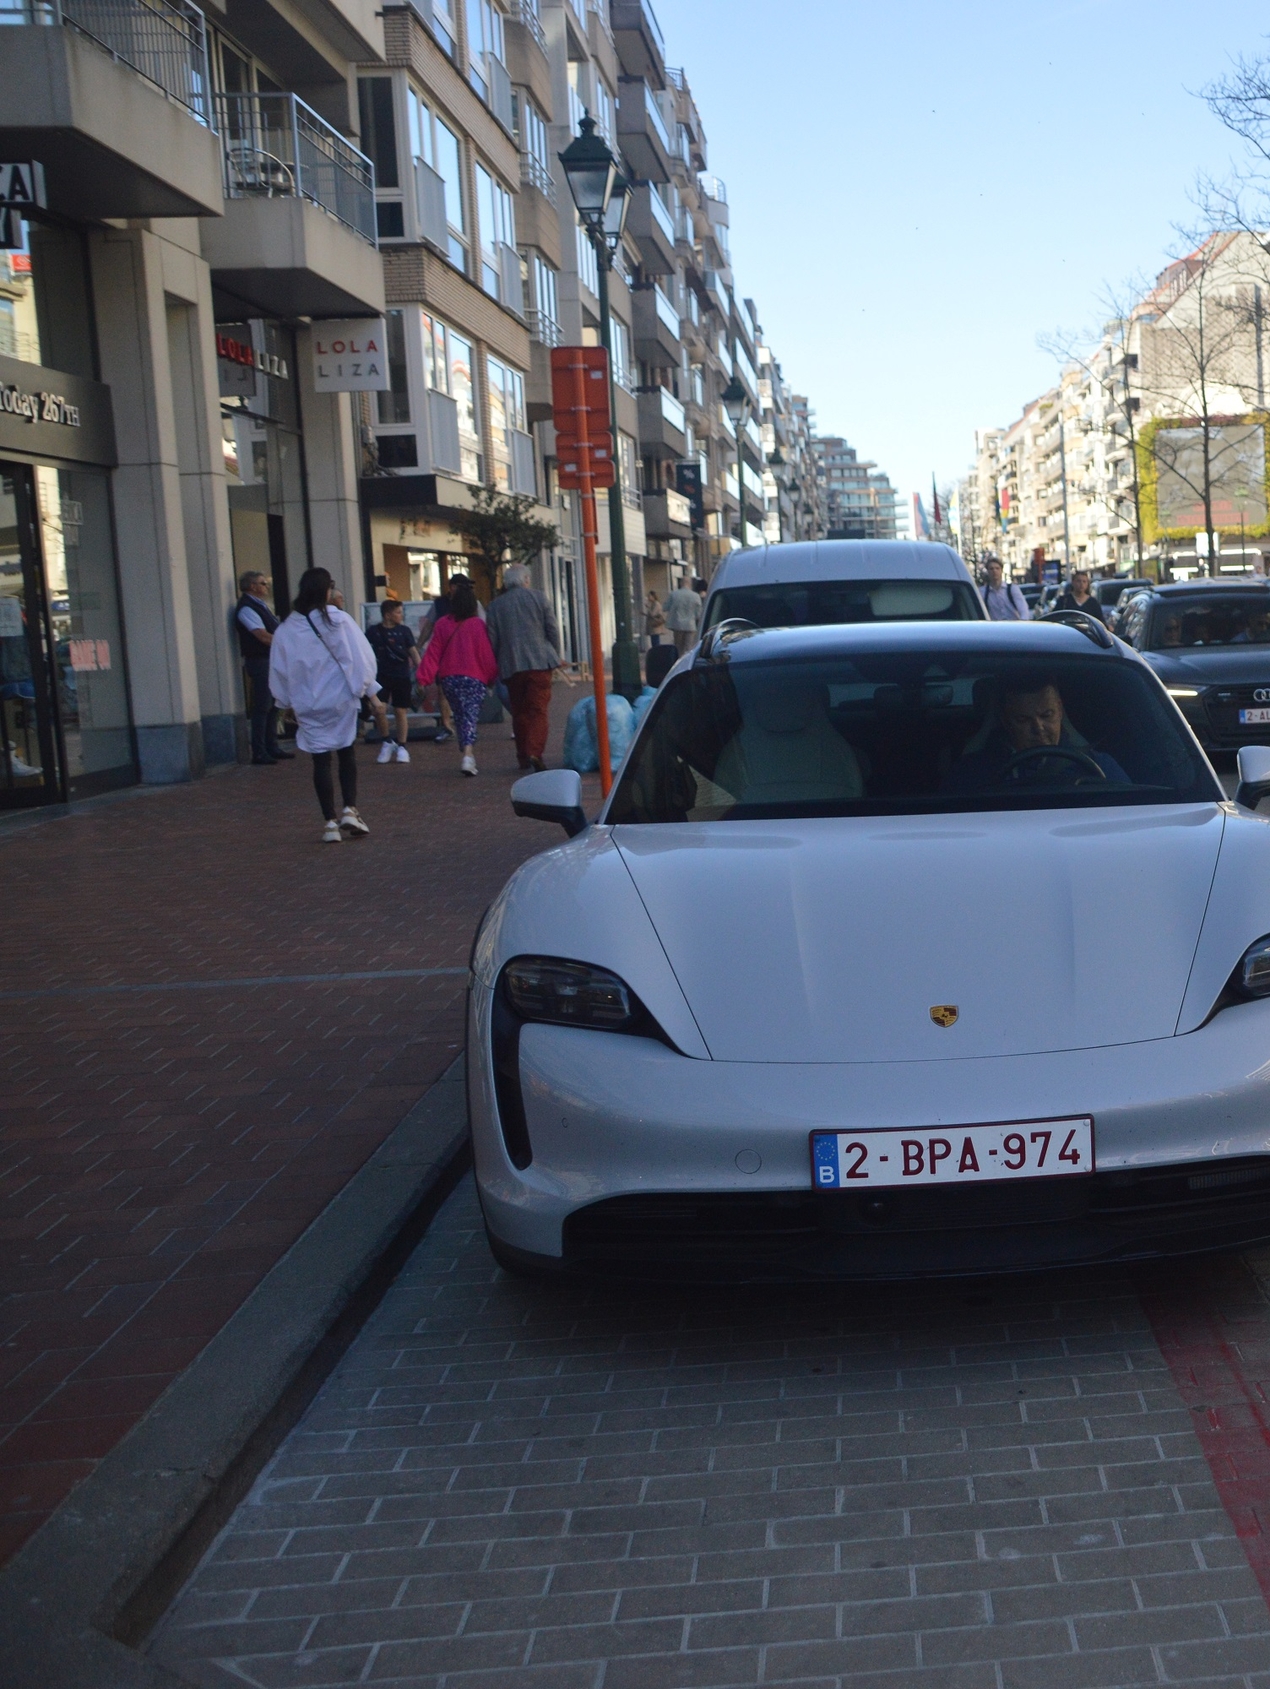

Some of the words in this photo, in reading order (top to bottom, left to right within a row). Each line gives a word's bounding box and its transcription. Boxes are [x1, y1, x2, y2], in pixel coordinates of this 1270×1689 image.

[215, 332, 255, 366] LOLA
[254, 349, 289, 379] LIZA
[316, 339, 379, 355] LOLA
[317, 363, 380, 378] LIZA
[819, 1166, 835, 1184] B
[845, 1129, 1081, 1179] 2-BPA-974
